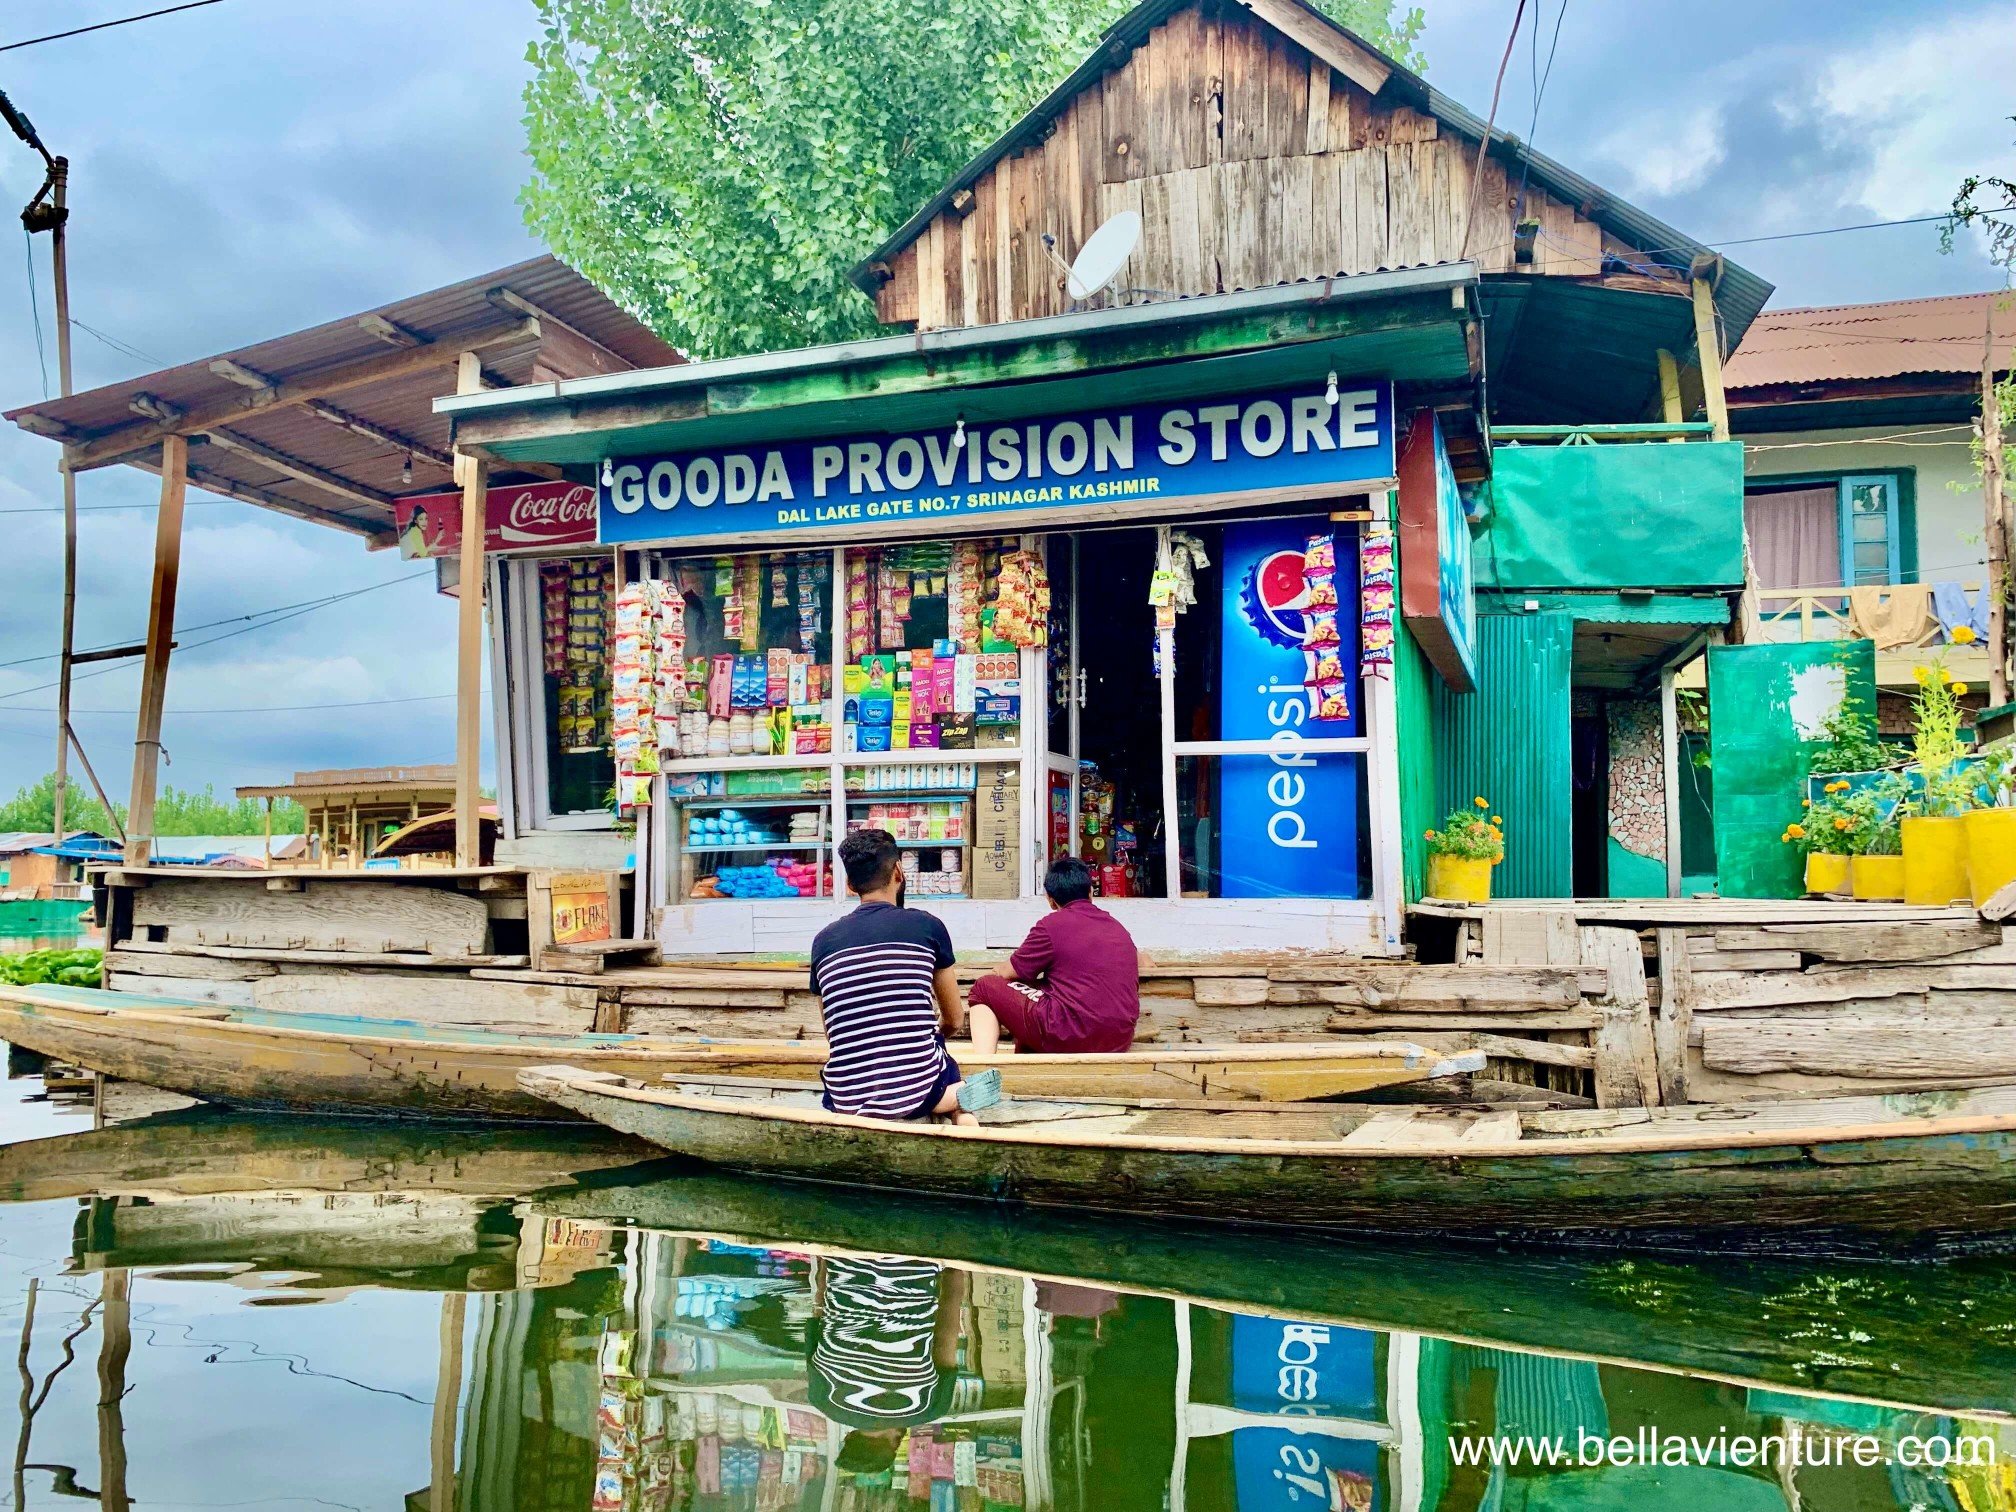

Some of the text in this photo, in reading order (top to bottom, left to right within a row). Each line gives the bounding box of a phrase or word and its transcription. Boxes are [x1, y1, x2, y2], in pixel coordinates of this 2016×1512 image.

[611, 389, 1380, 514] GOODA PROVISION STORE
[777, 477, 1160, 524] DAL LAKE GATE NO.7 SRINAGAR KASHMIR
[1308, 535, 1330, 548] Pasta
[1258, 684, 1318, 849] pepsi
[574, 903, 607, 929] FLAKE
